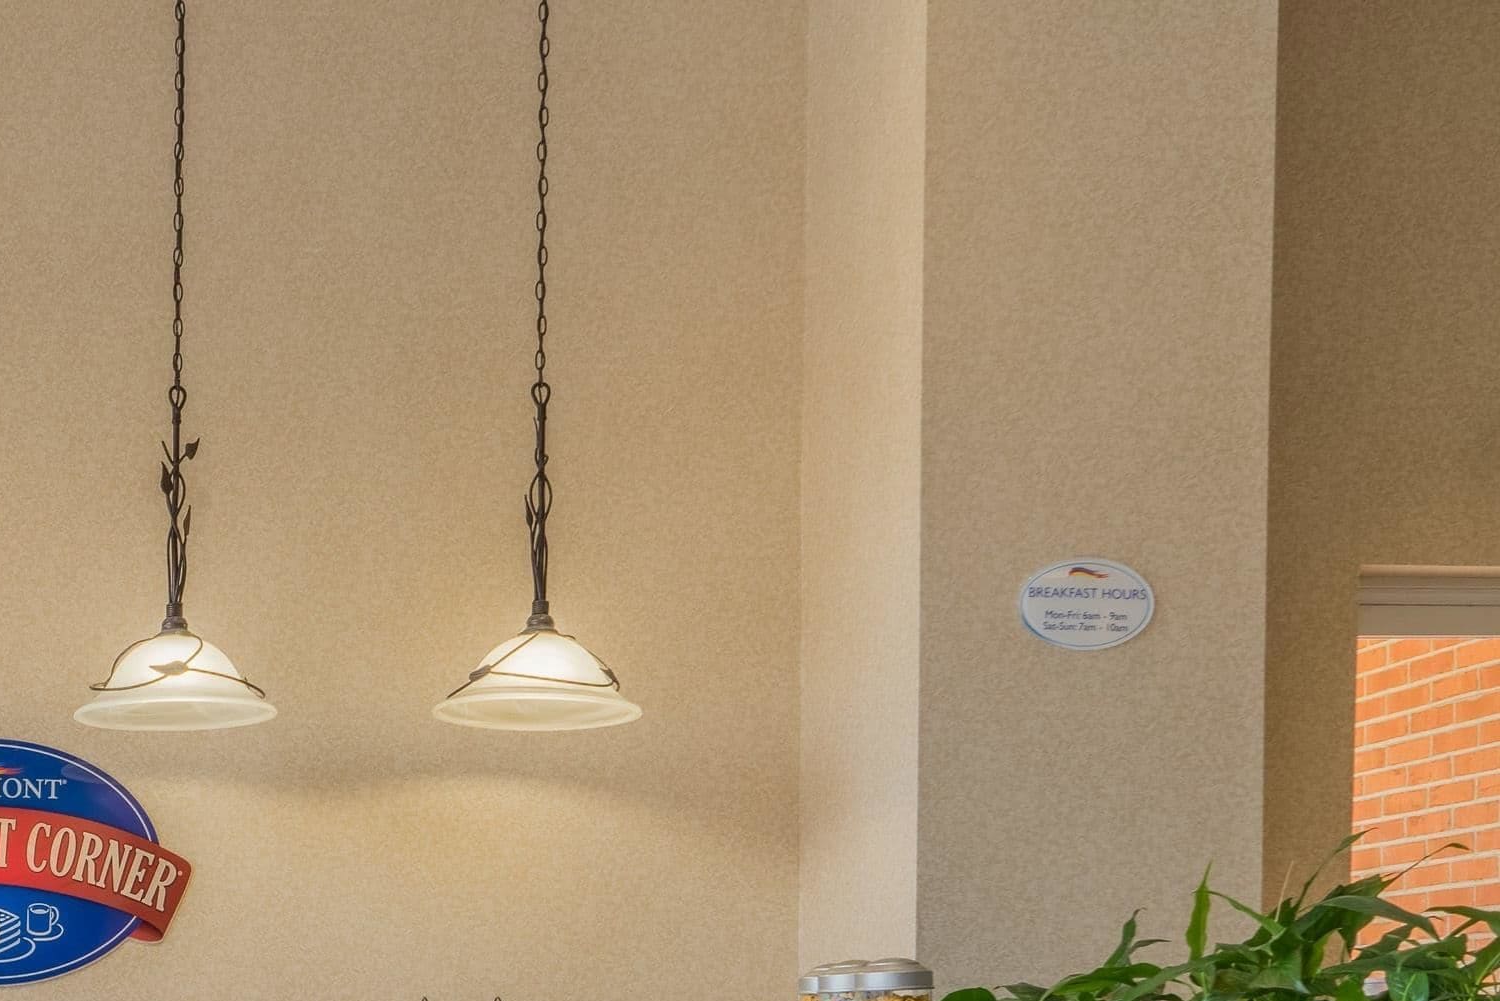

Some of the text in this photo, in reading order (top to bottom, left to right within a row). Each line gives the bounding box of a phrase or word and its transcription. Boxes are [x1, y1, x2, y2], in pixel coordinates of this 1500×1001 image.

[1028, 586, 1148, 600] BREAKFAST HOURS
[26, 822, 178, 913] CORNER
